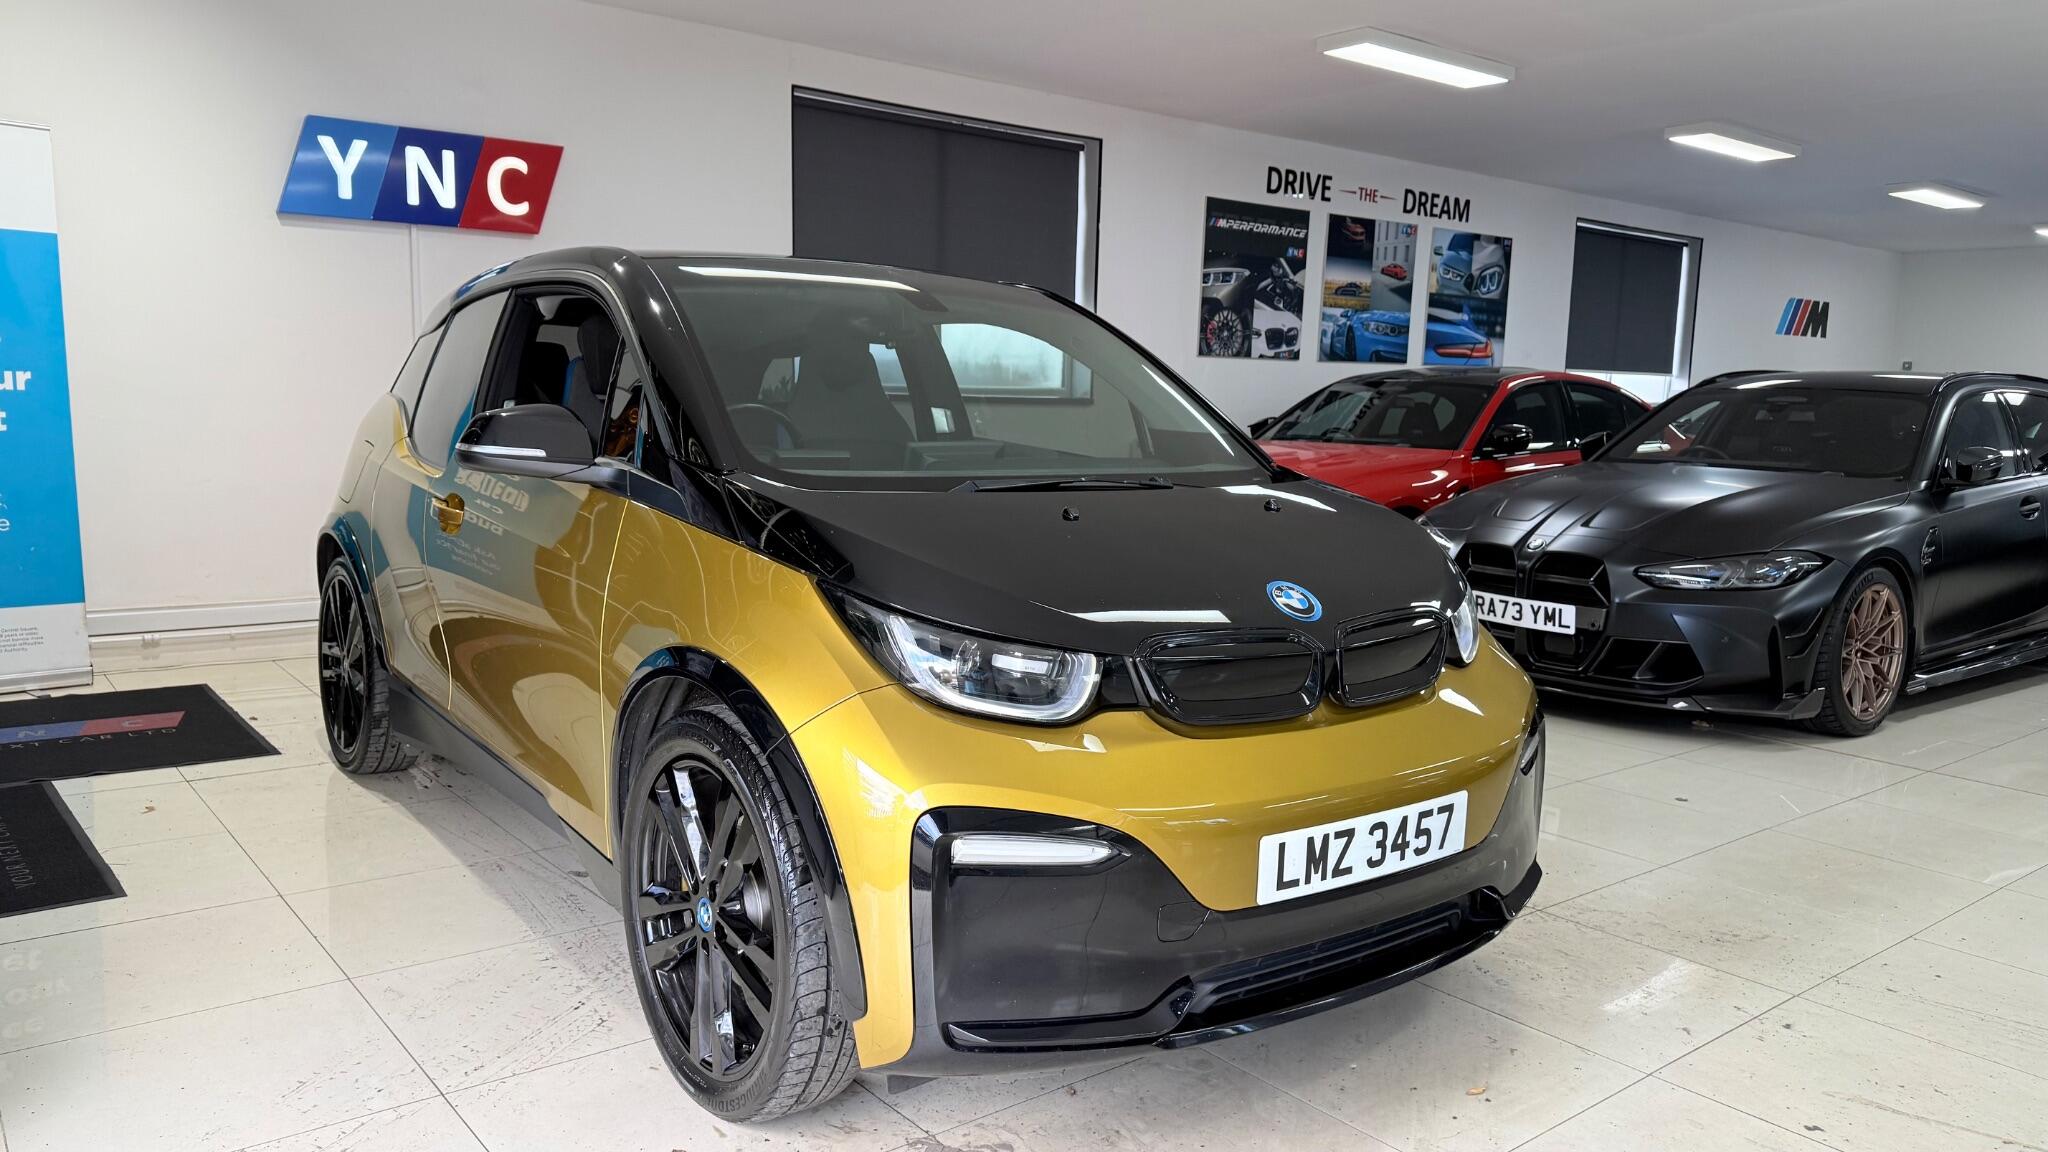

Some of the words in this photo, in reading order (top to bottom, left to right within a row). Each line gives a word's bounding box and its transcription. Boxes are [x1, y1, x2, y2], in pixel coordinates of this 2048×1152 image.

[316, 134, 530, 217] YNC
[1266, 165, 1333, 203] DRIVE
[1358, 187, 1379, 204] THE
[1402, 188, 1471, 223] DREAM
[1475, 594, 1523, 622] RA73
[1530, 603, 1571, 630] YML
[58, 734, 113, 744] CAR
[127, 727, 177, 738] LTD
[1275, 827, 1356, 892] LMZ
[1366, 802, 1455, 869] 3457
